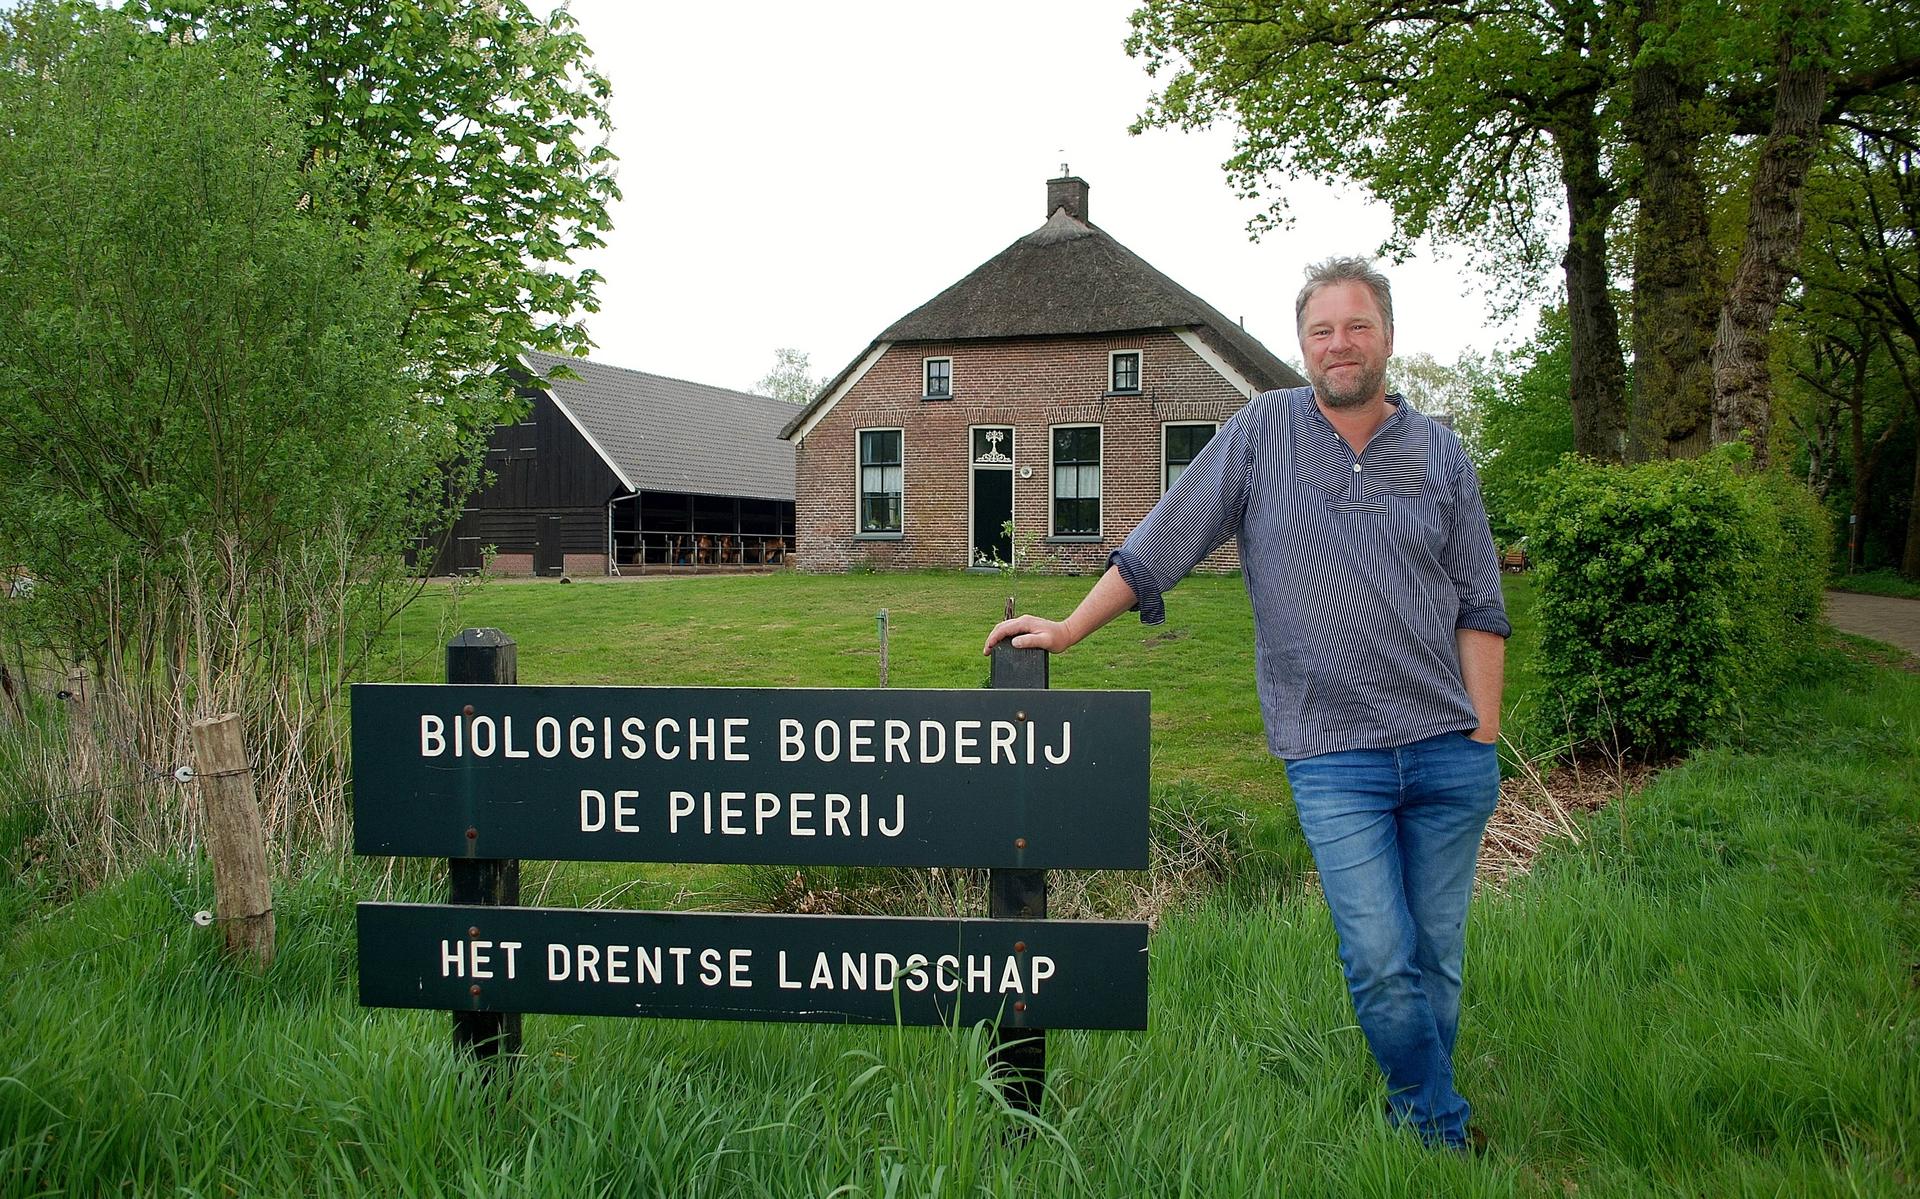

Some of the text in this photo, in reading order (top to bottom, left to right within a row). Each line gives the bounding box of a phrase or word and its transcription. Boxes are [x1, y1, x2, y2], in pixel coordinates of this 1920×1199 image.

[420, 714, 1072, 765] BIOLOGISCHE BOERDERIJ
[580, 789, 905, 837] DE PIEPERIJ
[440, 939, 1057, 994] HET DRENTSE LANDSCHAP
